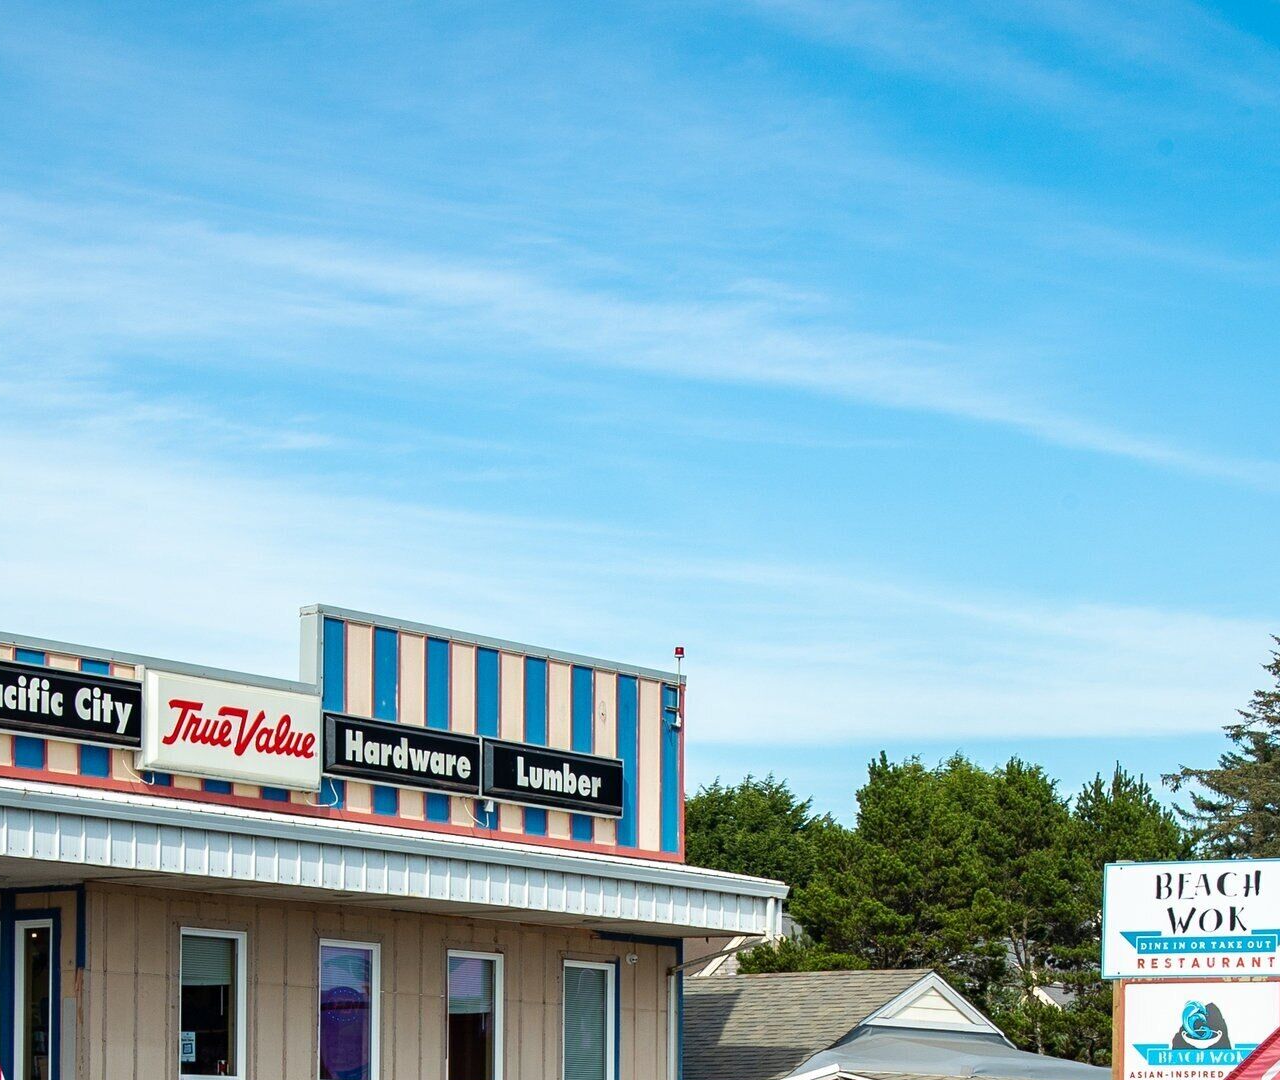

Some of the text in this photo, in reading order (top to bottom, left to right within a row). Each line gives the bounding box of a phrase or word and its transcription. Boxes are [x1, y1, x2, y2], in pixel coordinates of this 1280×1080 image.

[75, 686, 132, 734] City
[345, 729, 471, 779] Hardware
[517, 756, 601, 798] Lumber
[1155, 870, 1262, 900] BEACH
[1167, 906, 1247, 934] WOK
[1140, 940, 1271, 951] DINE IN OR TAKE OUT
[1137, 956, 1276, 969] RESTAURANT
[1158, 1051, 1205, 1064] BEACH
[1129, 1070, 1224, 1079] ASIAN-INSPIRED
